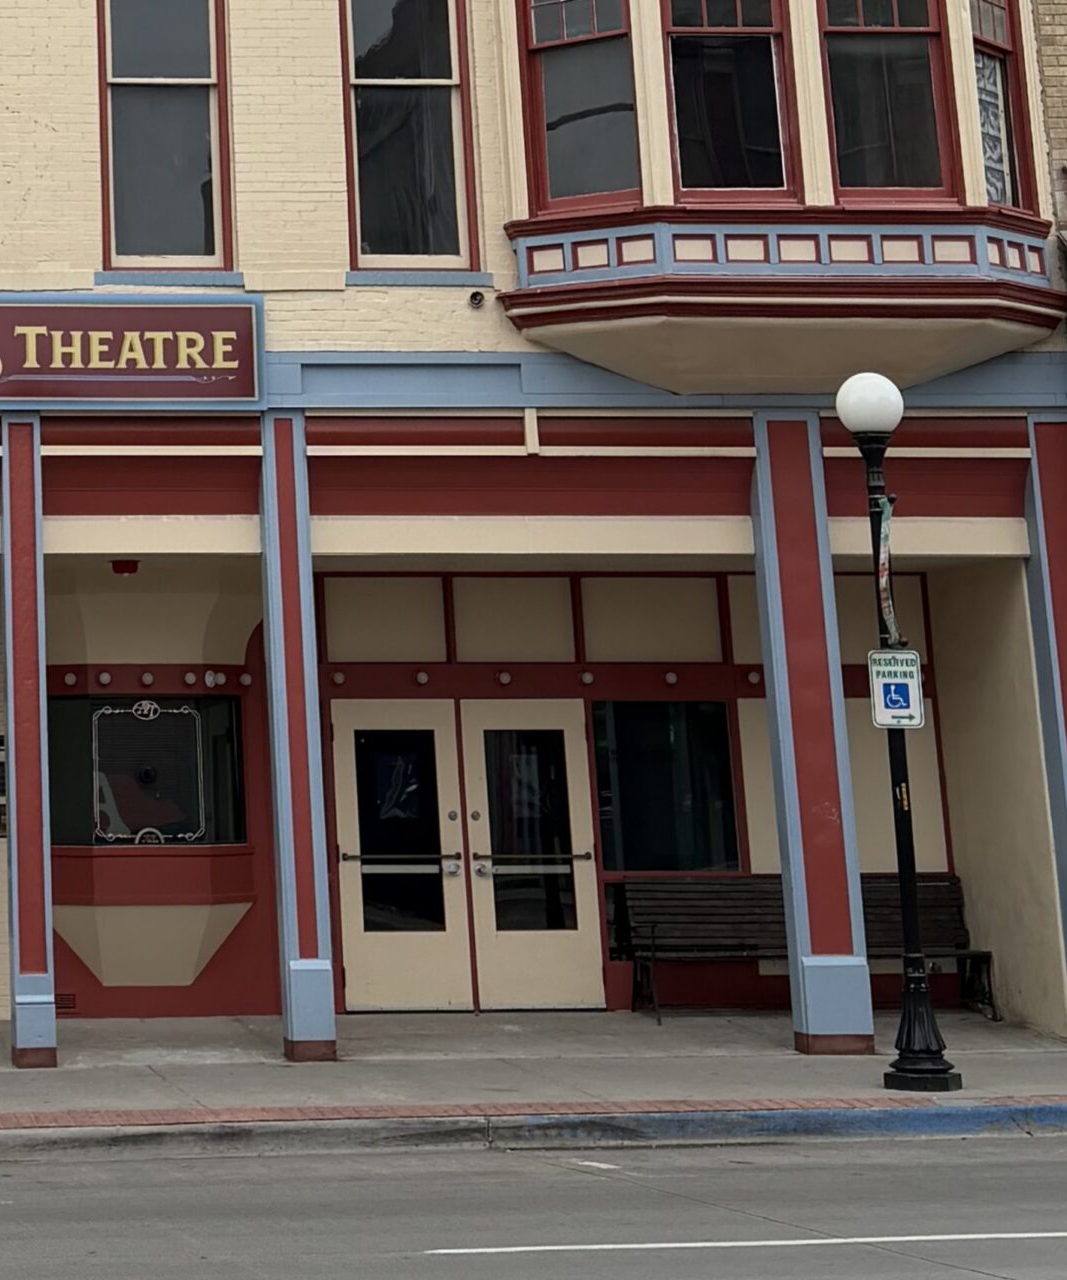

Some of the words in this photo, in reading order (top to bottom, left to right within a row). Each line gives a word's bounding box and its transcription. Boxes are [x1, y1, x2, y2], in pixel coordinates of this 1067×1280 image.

[14, 325, 239, 369] THEATRE
[872, 658, 916, 667] RESERVED
[876, 670, 915, 679] PARKING
